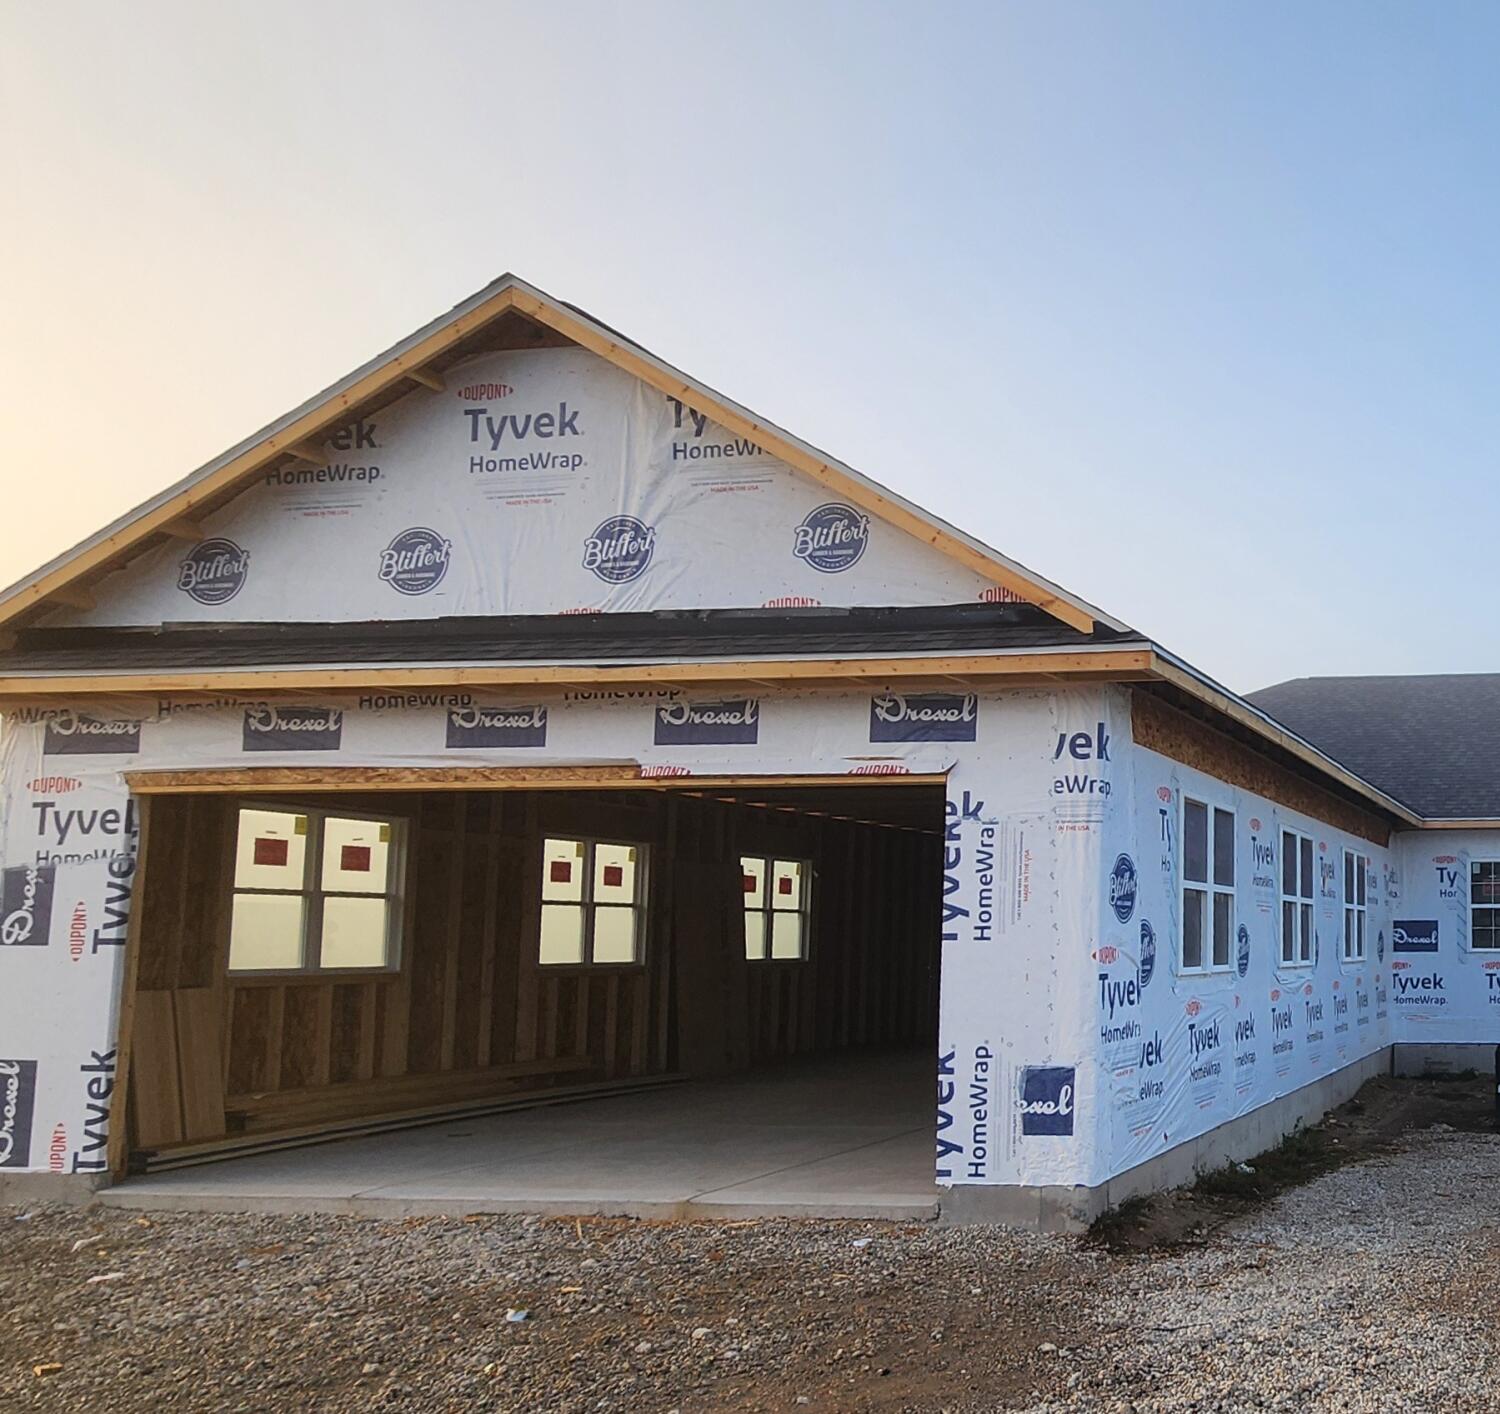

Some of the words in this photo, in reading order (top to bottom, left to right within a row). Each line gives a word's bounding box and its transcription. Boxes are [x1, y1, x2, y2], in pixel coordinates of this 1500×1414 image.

[464, 384, 508, 401] DUPONT
[464, 402, 580, 451] Tyvek
[265, 464, 380, 485] HomeWrap
[470, 453, 583, 473] HomeWrap
[584, 528, 655, 569] Bliffert
[794, 516, 869, 558] Bliffert
[179, 551, 250, 590] Bliffert
[379, 539, 452, 580] Bliffert
[249, 705, 342, 732] Drexel
[452, 705, 547, 730] Drexel
[659, 698, 757, 725] Drexel
[874, 693, 977, 723] Drexel
[32, 776, 78, 794] DUPONT
[1055, 775, 1112, 799] eWrap
[2, 867, 40, 945] Drex
[91, 838, 137, 954] Tyve
[70, 907, 87, 955] DUPONT
[1393, 927, 1438, 945] Drexel
[1393, 973, 1444, 995] Tyvek
[1271, 1003, 1293, 1040] Tyvek
[1305, 998, 1324, 1029] Tyvek
[1188, 1018, 1220, 1062] Tyvek
[1018, 1084, 1073, 1116] exel
[1139, 1080, 1163, 1101] eWrap
[968, 1045, 993, 1178] HomeWrap
[50, 1130, 67, 1172] UPONT
